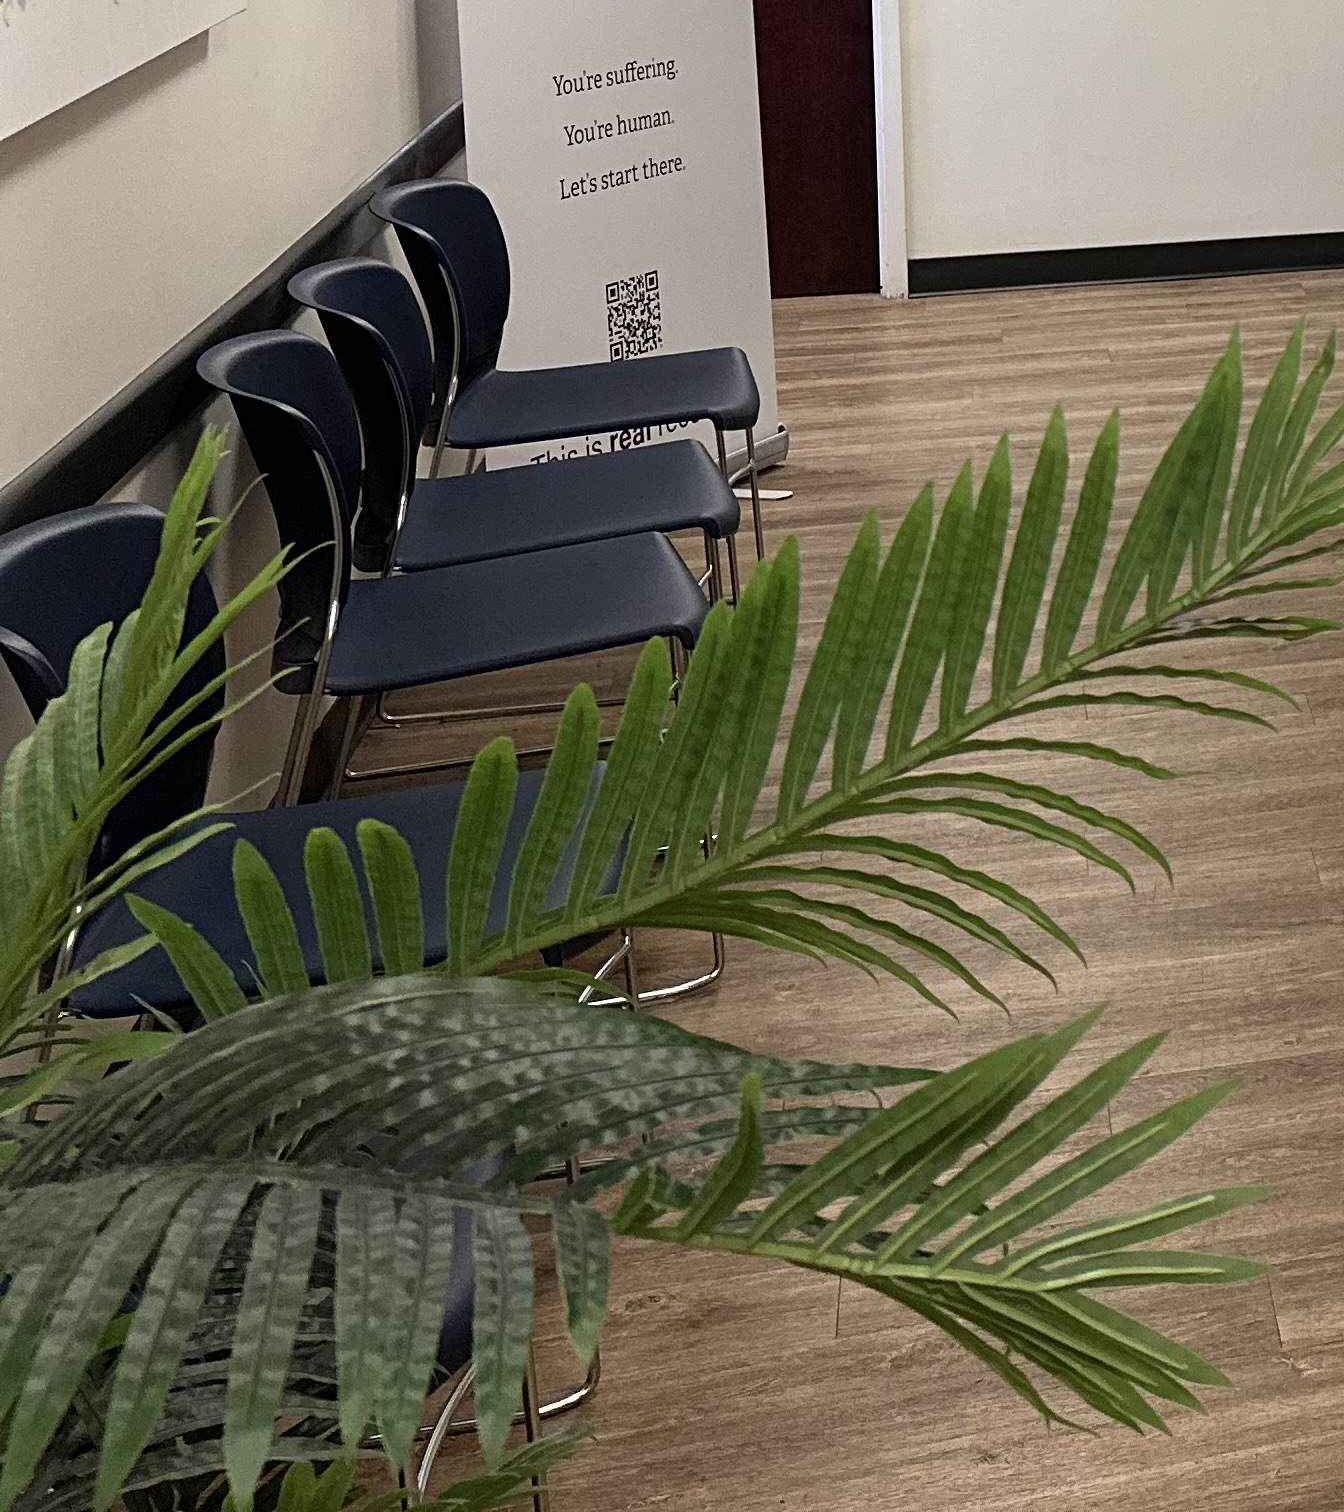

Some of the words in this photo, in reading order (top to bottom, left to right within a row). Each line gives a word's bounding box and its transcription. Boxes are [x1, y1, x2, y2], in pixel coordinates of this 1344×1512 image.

[553, 71, 602, 96] You're
[606, 57, 679, 87] suffering.
[563, 120, 614, 147] You're
[616, 108, 675, 136] human.
[559, 173, 598, 200] Let's
[601, 164, 639, 191] start
[642, 152, 686, 182] there.
